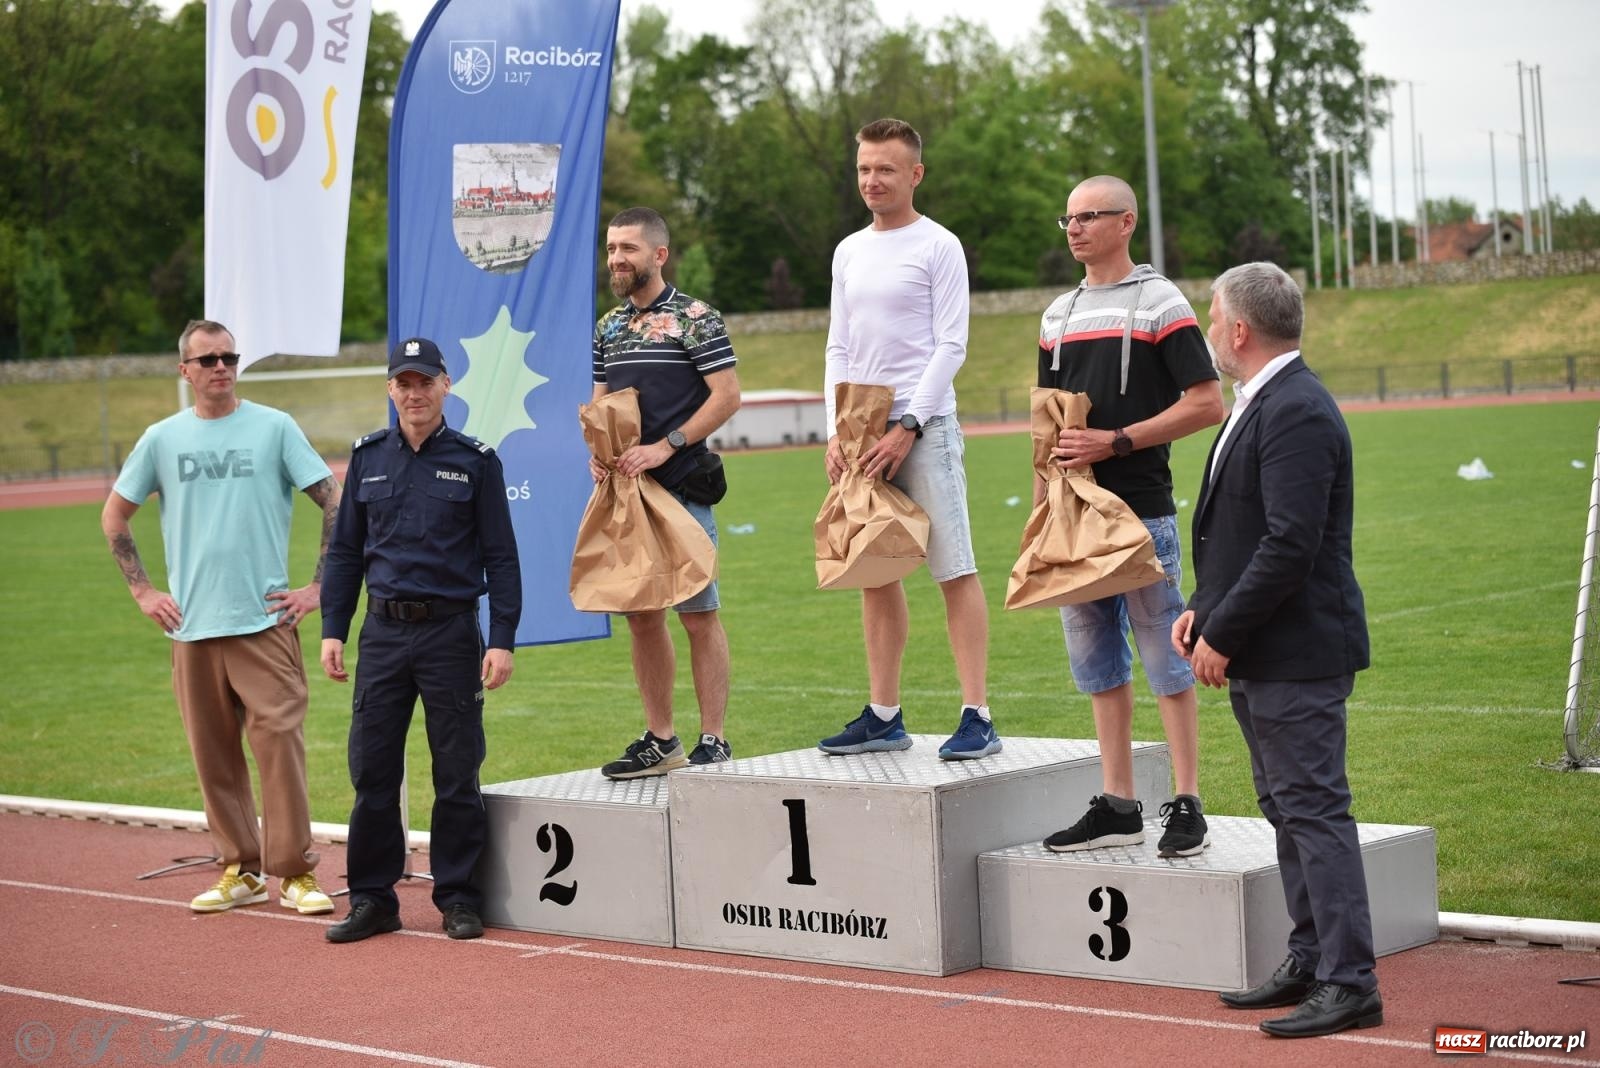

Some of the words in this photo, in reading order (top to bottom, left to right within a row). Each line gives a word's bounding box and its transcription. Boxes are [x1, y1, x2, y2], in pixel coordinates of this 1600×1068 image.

[505, 46, 602, 67] Racibórz
[504, 71, 532, 86] 1217
[436, 470, 469, 483] POLICJA
[506, 480, 531, 500] oś
[781, 798, 817, 887] 1
[535, 822, 578, 906] 2
[722, 902, 773, 928] OSIR
[778, 909, 888, 940] RACIBÓRZ
[1088, 886, 1131, 962] 3
